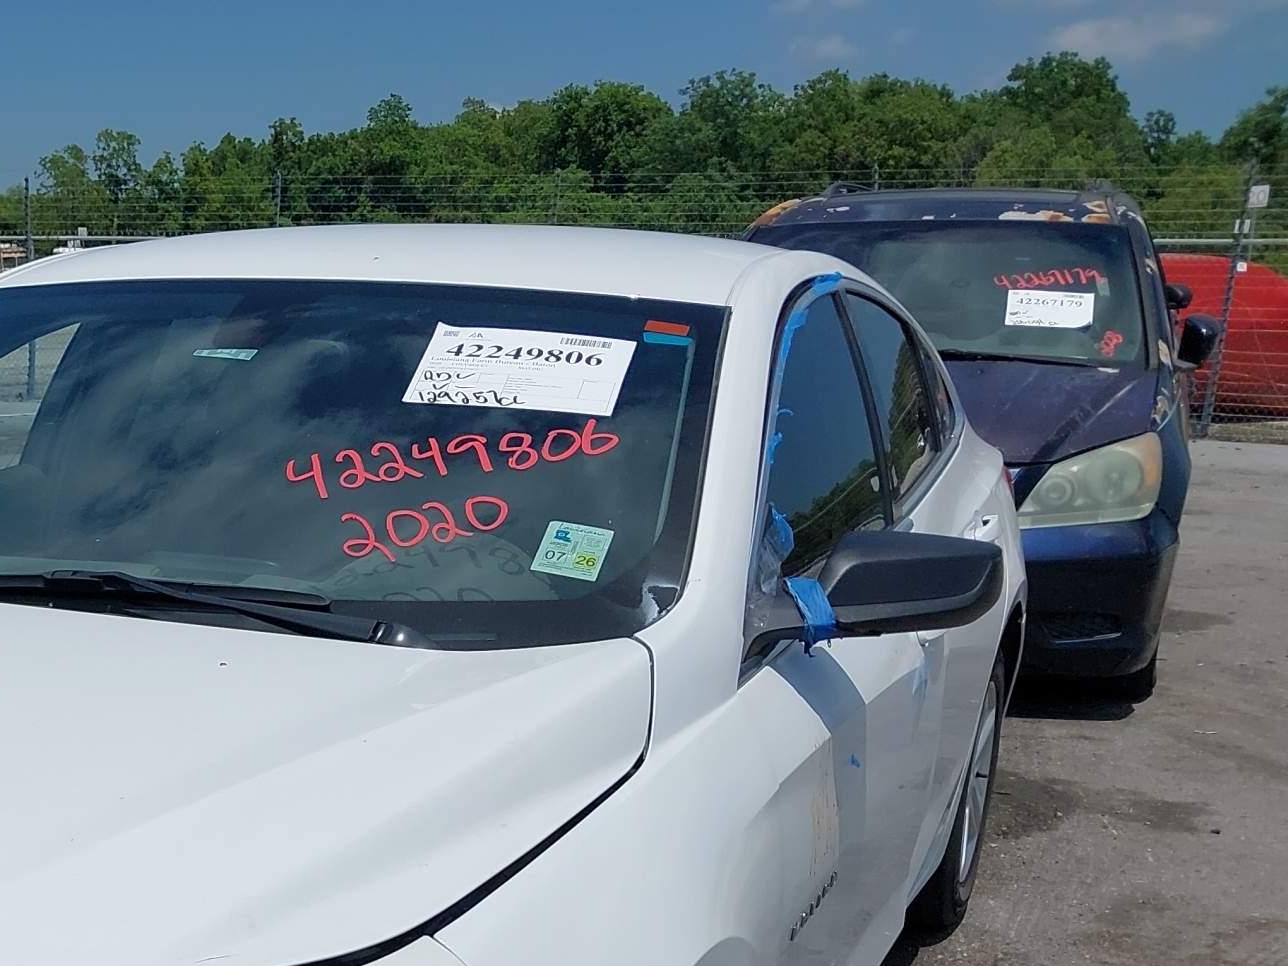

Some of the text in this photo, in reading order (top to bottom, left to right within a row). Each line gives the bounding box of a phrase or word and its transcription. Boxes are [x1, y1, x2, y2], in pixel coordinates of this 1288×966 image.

[1015, 297, 1083, 309] 42267179
[445, 342, 604, 367] 42249806
[285, 418, 620, 500] 42249806
[340, 495, 509, 563] 2020
[544, 549, 567, 562] 07
[575, 554, 597, 567] 26
